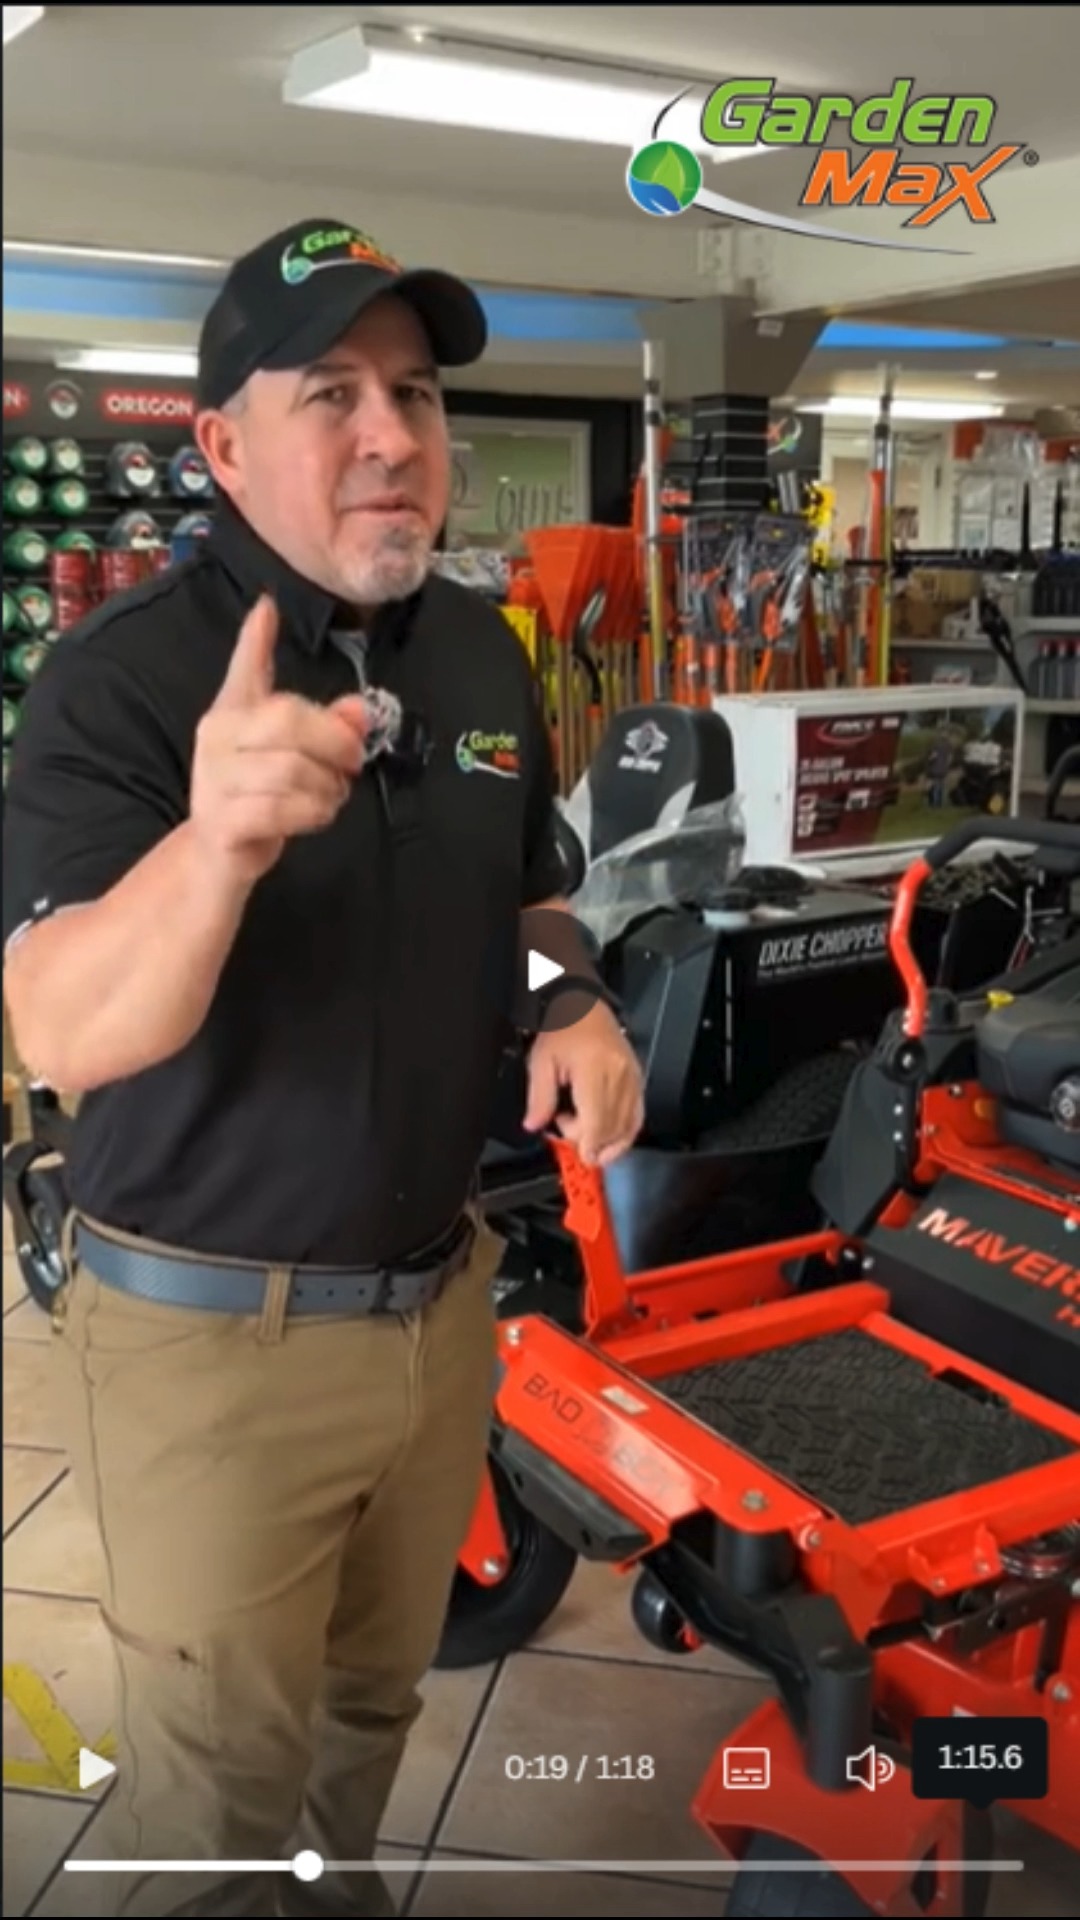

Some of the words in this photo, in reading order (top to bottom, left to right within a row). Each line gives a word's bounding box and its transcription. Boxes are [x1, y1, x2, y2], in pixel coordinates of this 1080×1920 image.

[105, 393, 194, 417] OREGON
[759, 935, 808, 967] DIXIE
[523, 1372, 584, 1424] BAD
